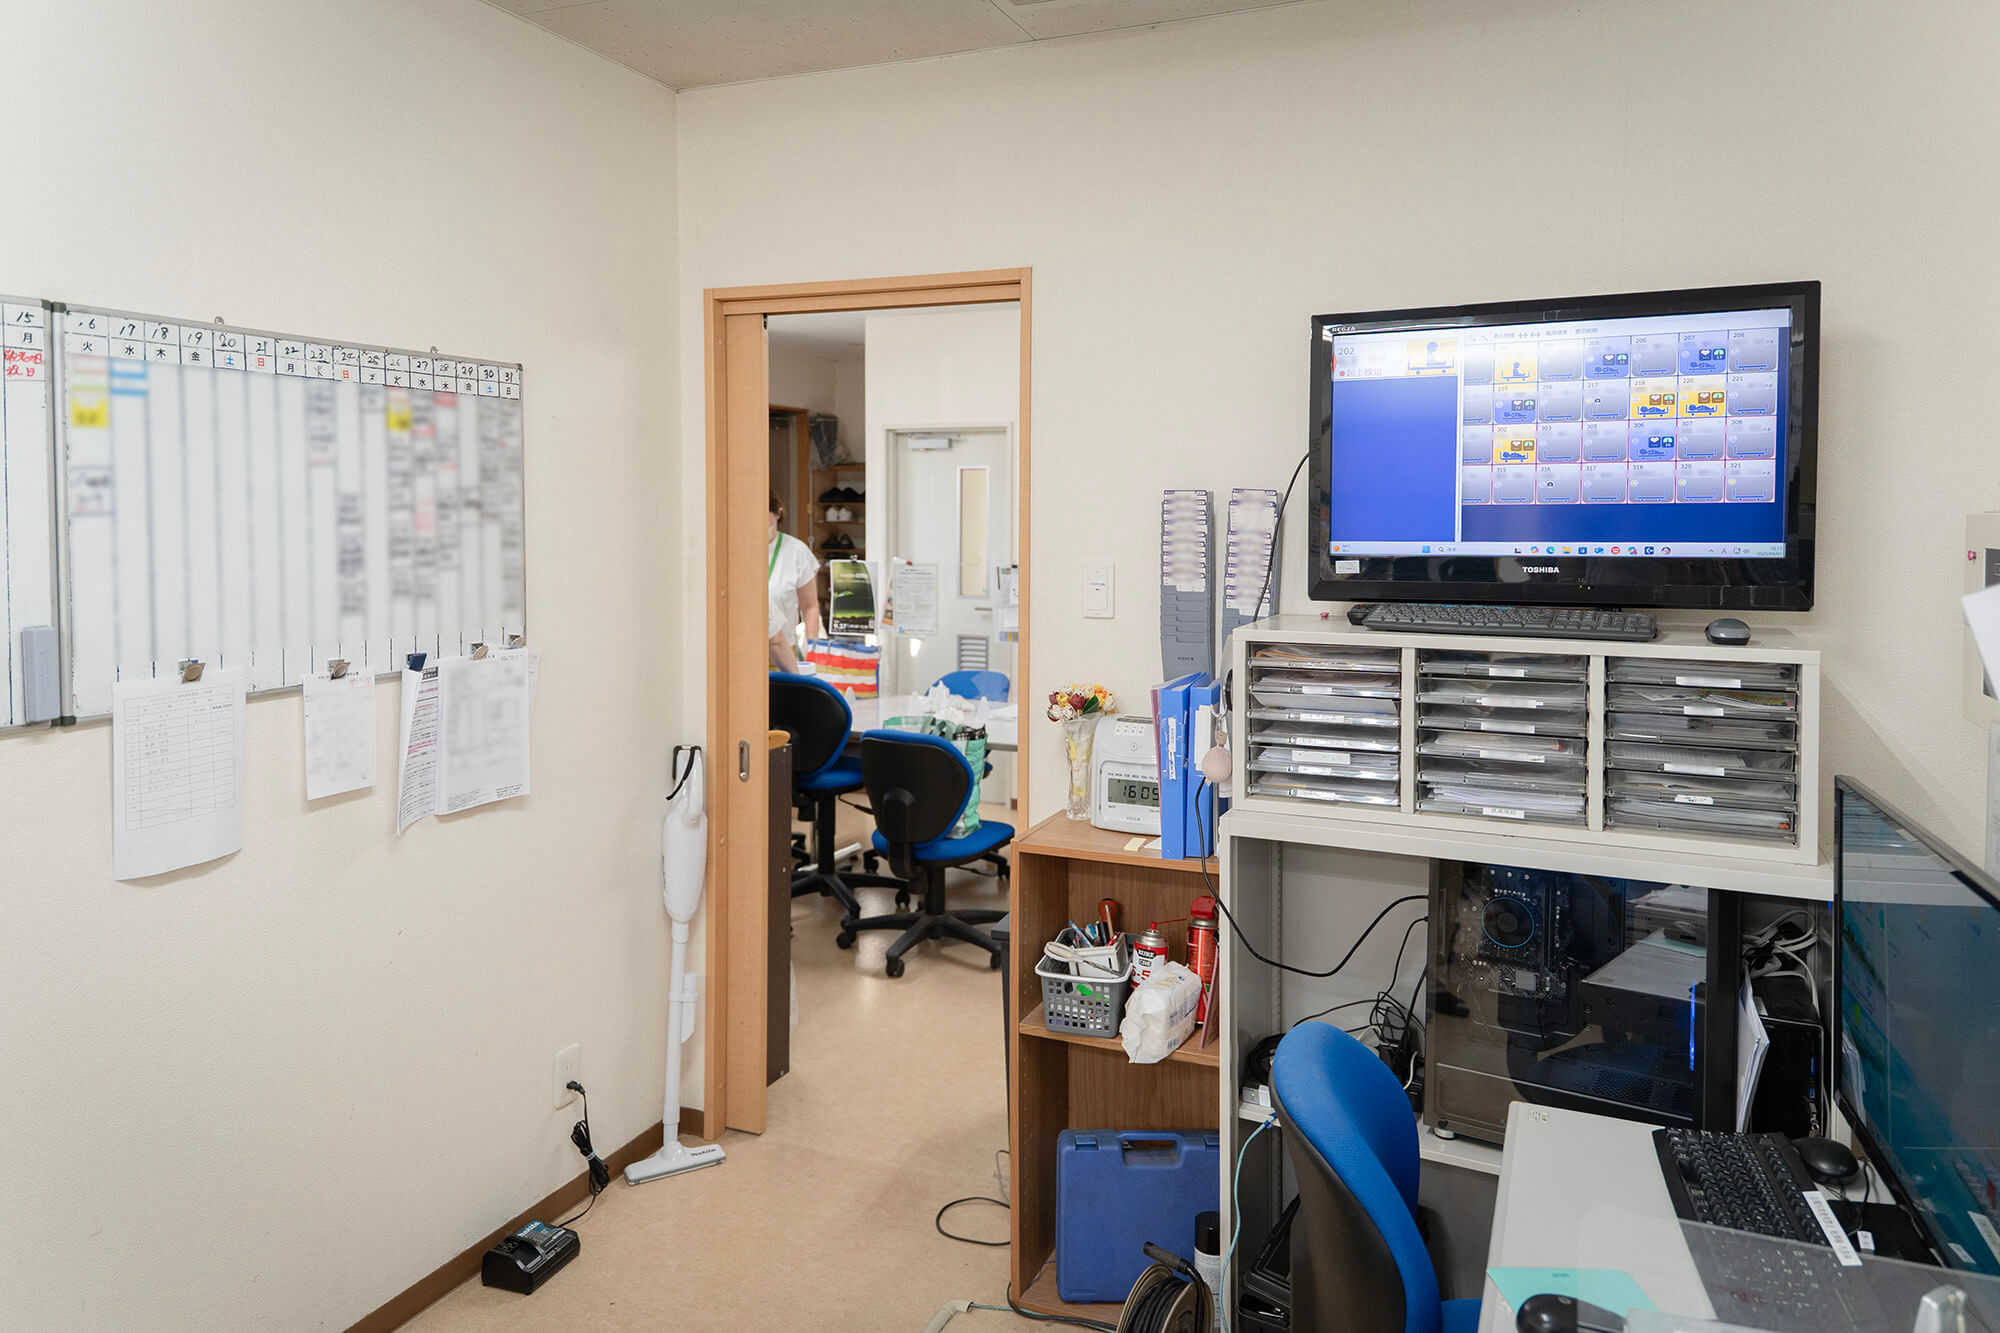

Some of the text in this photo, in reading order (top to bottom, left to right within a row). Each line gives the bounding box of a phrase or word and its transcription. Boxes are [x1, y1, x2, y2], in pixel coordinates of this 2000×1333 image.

[16, 312, 35, 323] 15
[119, 323, 136, 336] 17
[152, 327, 169, 339] 18
[23, 332, 33, 343] 月
[187, 332, 203, 345] 19
[219, 333, 236, 347] 20
[83, 341, 93, 352] 火
[125, 346, 135, 355] 水
[285, 347, 299, 355] 22
[1338, 347, 1355, 355] 202
[156, 348, 166, 358] 木
[191, 351, 200, 361] 金
[310, 348, 324, 359] 23
[225, 355, 235, 366] 土
[257, 357, 265, 367] 日
[287, 363, 295, 373] 月
[416, 361, 429, 371] 27
[440, 363, 450, 371] 28
[461, 366, 474, 376] 29
[342, 370, 350, 379] 日
[483, 369, 494, 379] 30
[505, 372, 513, 382] 31
